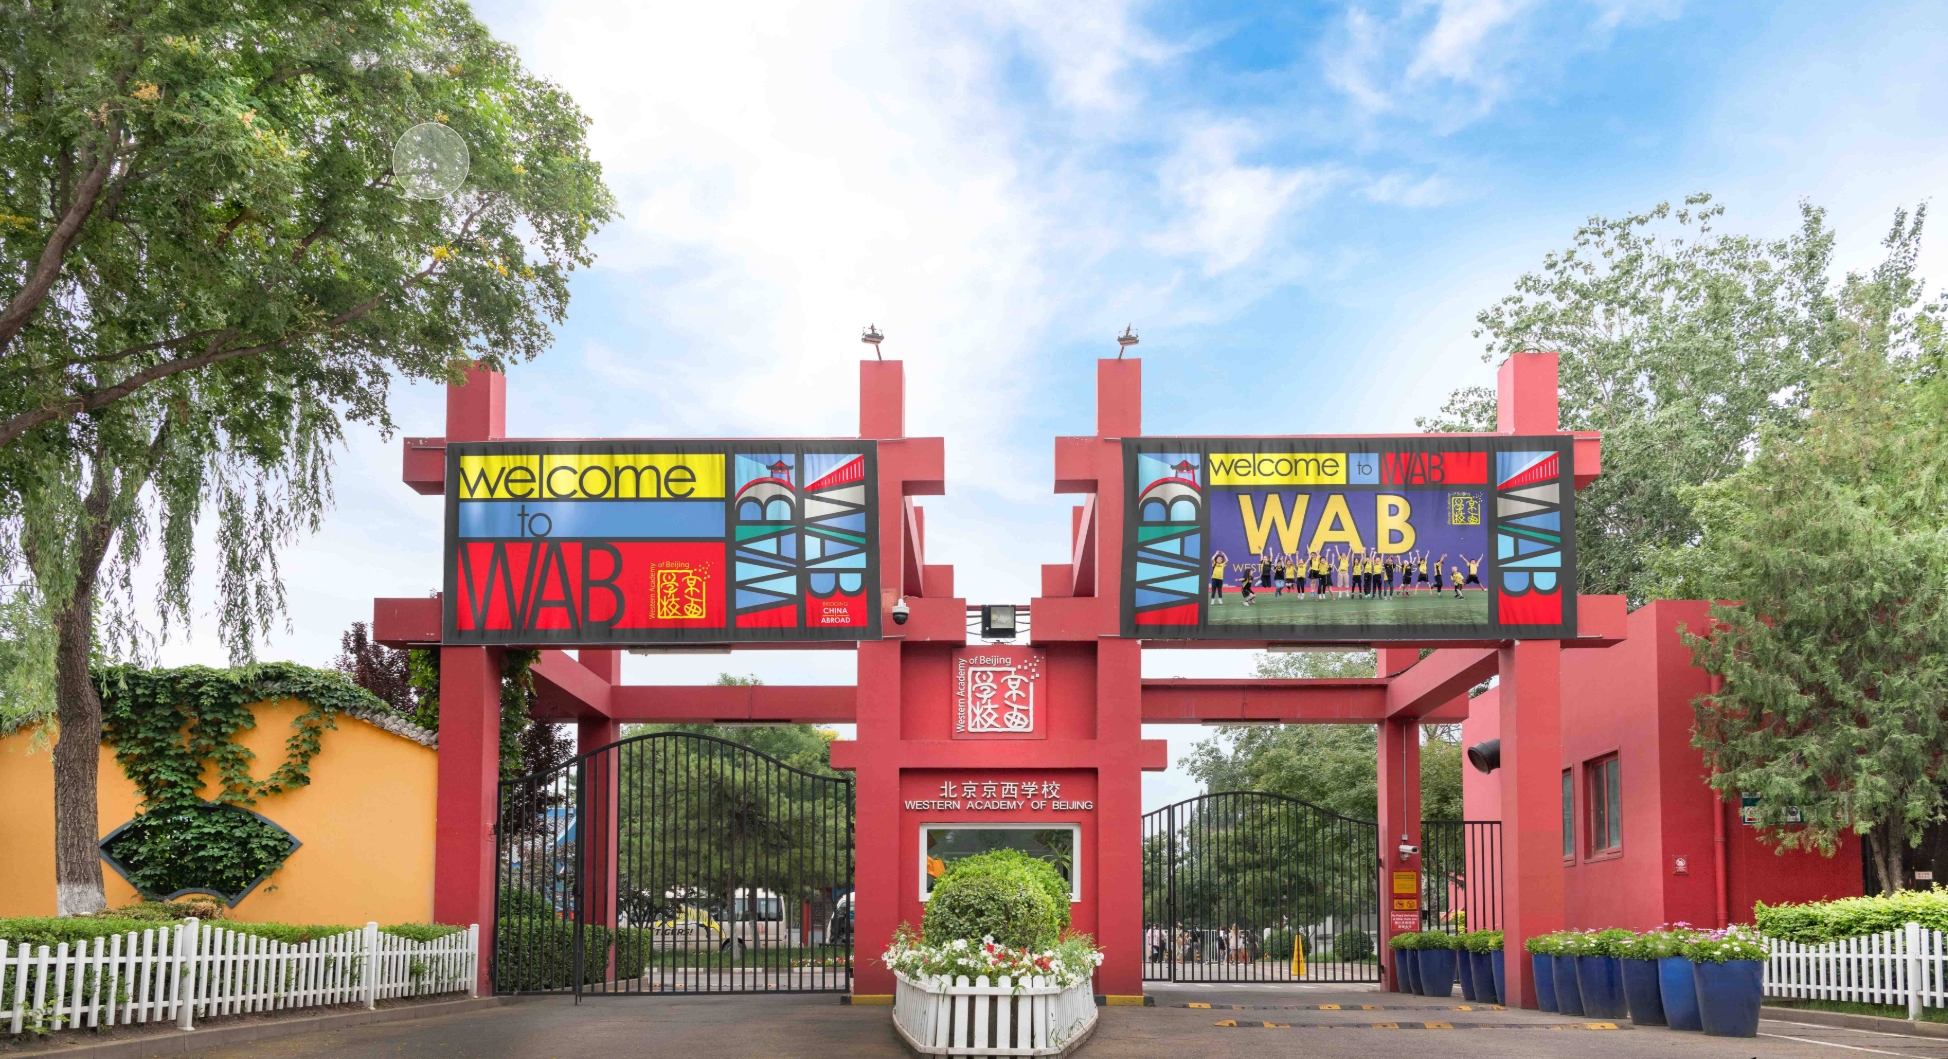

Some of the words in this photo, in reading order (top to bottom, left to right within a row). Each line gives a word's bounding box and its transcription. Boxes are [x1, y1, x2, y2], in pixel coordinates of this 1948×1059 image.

[460, 455, 696, 498] welcome
[1209, 453, 1339, 477] welcome
[1357, 461, 1373, 476] to
[1382, 453, 1445, 485] WAB
[517, 505, 552, 537] to
[1236, 493, 1416, 556] WAB
[648, 562, 657, 593] Academy
[666, 561, 690, 570] Beijing
[458, 542, 626, 630] WAB
[648, 593, 656, 620] Western
[968, 656, 979, 665] of
[979, 655, 1012, 667] Beijing
[956, 658, 967, 697] Academy
[956, 698, 966, 733] Western
[904, 800, 961, 810] WESTERN
[966, 800, 1025, 810] ACADEMY
[1031, 800, 1047, 810] OF
[1052, 800, 1094, 810] BEIJING
[940, 780, 1061, 799] 北京京西学校
[655, 928, 694, 936] TGRS!
